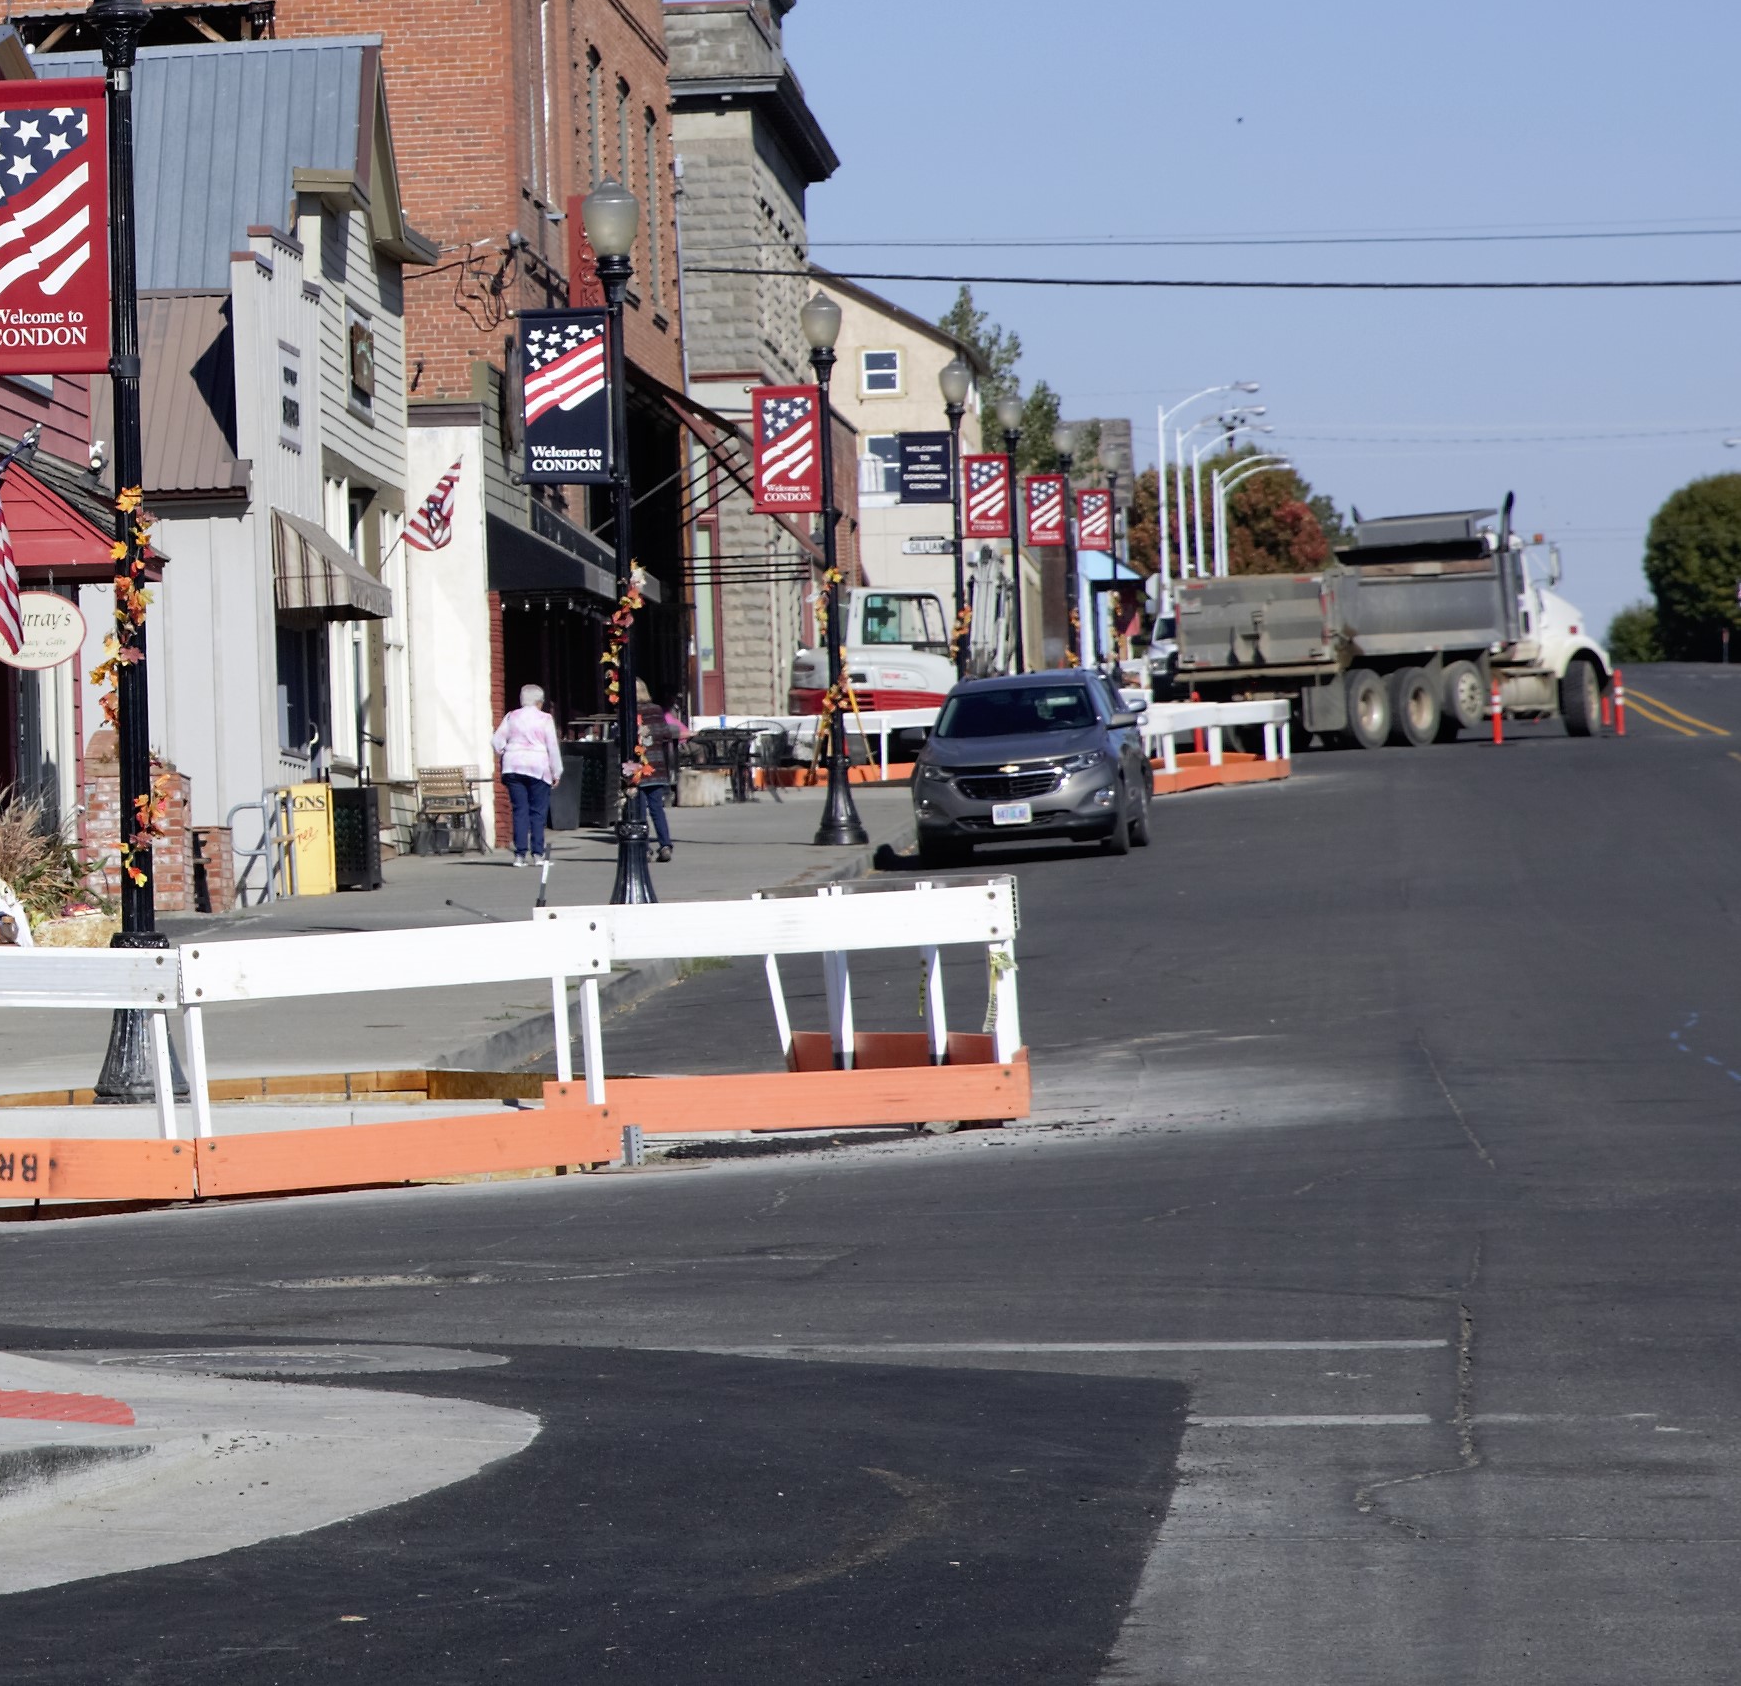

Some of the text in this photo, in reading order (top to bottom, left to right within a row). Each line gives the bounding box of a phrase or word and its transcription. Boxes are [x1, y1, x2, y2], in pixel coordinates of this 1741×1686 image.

[67, 310, 84, 323] to
[530, 445, 602, 458] Welcome to
[531, 458, 602, 471] CONDON
[764, 493, 811, 502] CONDON
[21, 606, 71, 630] urray's
